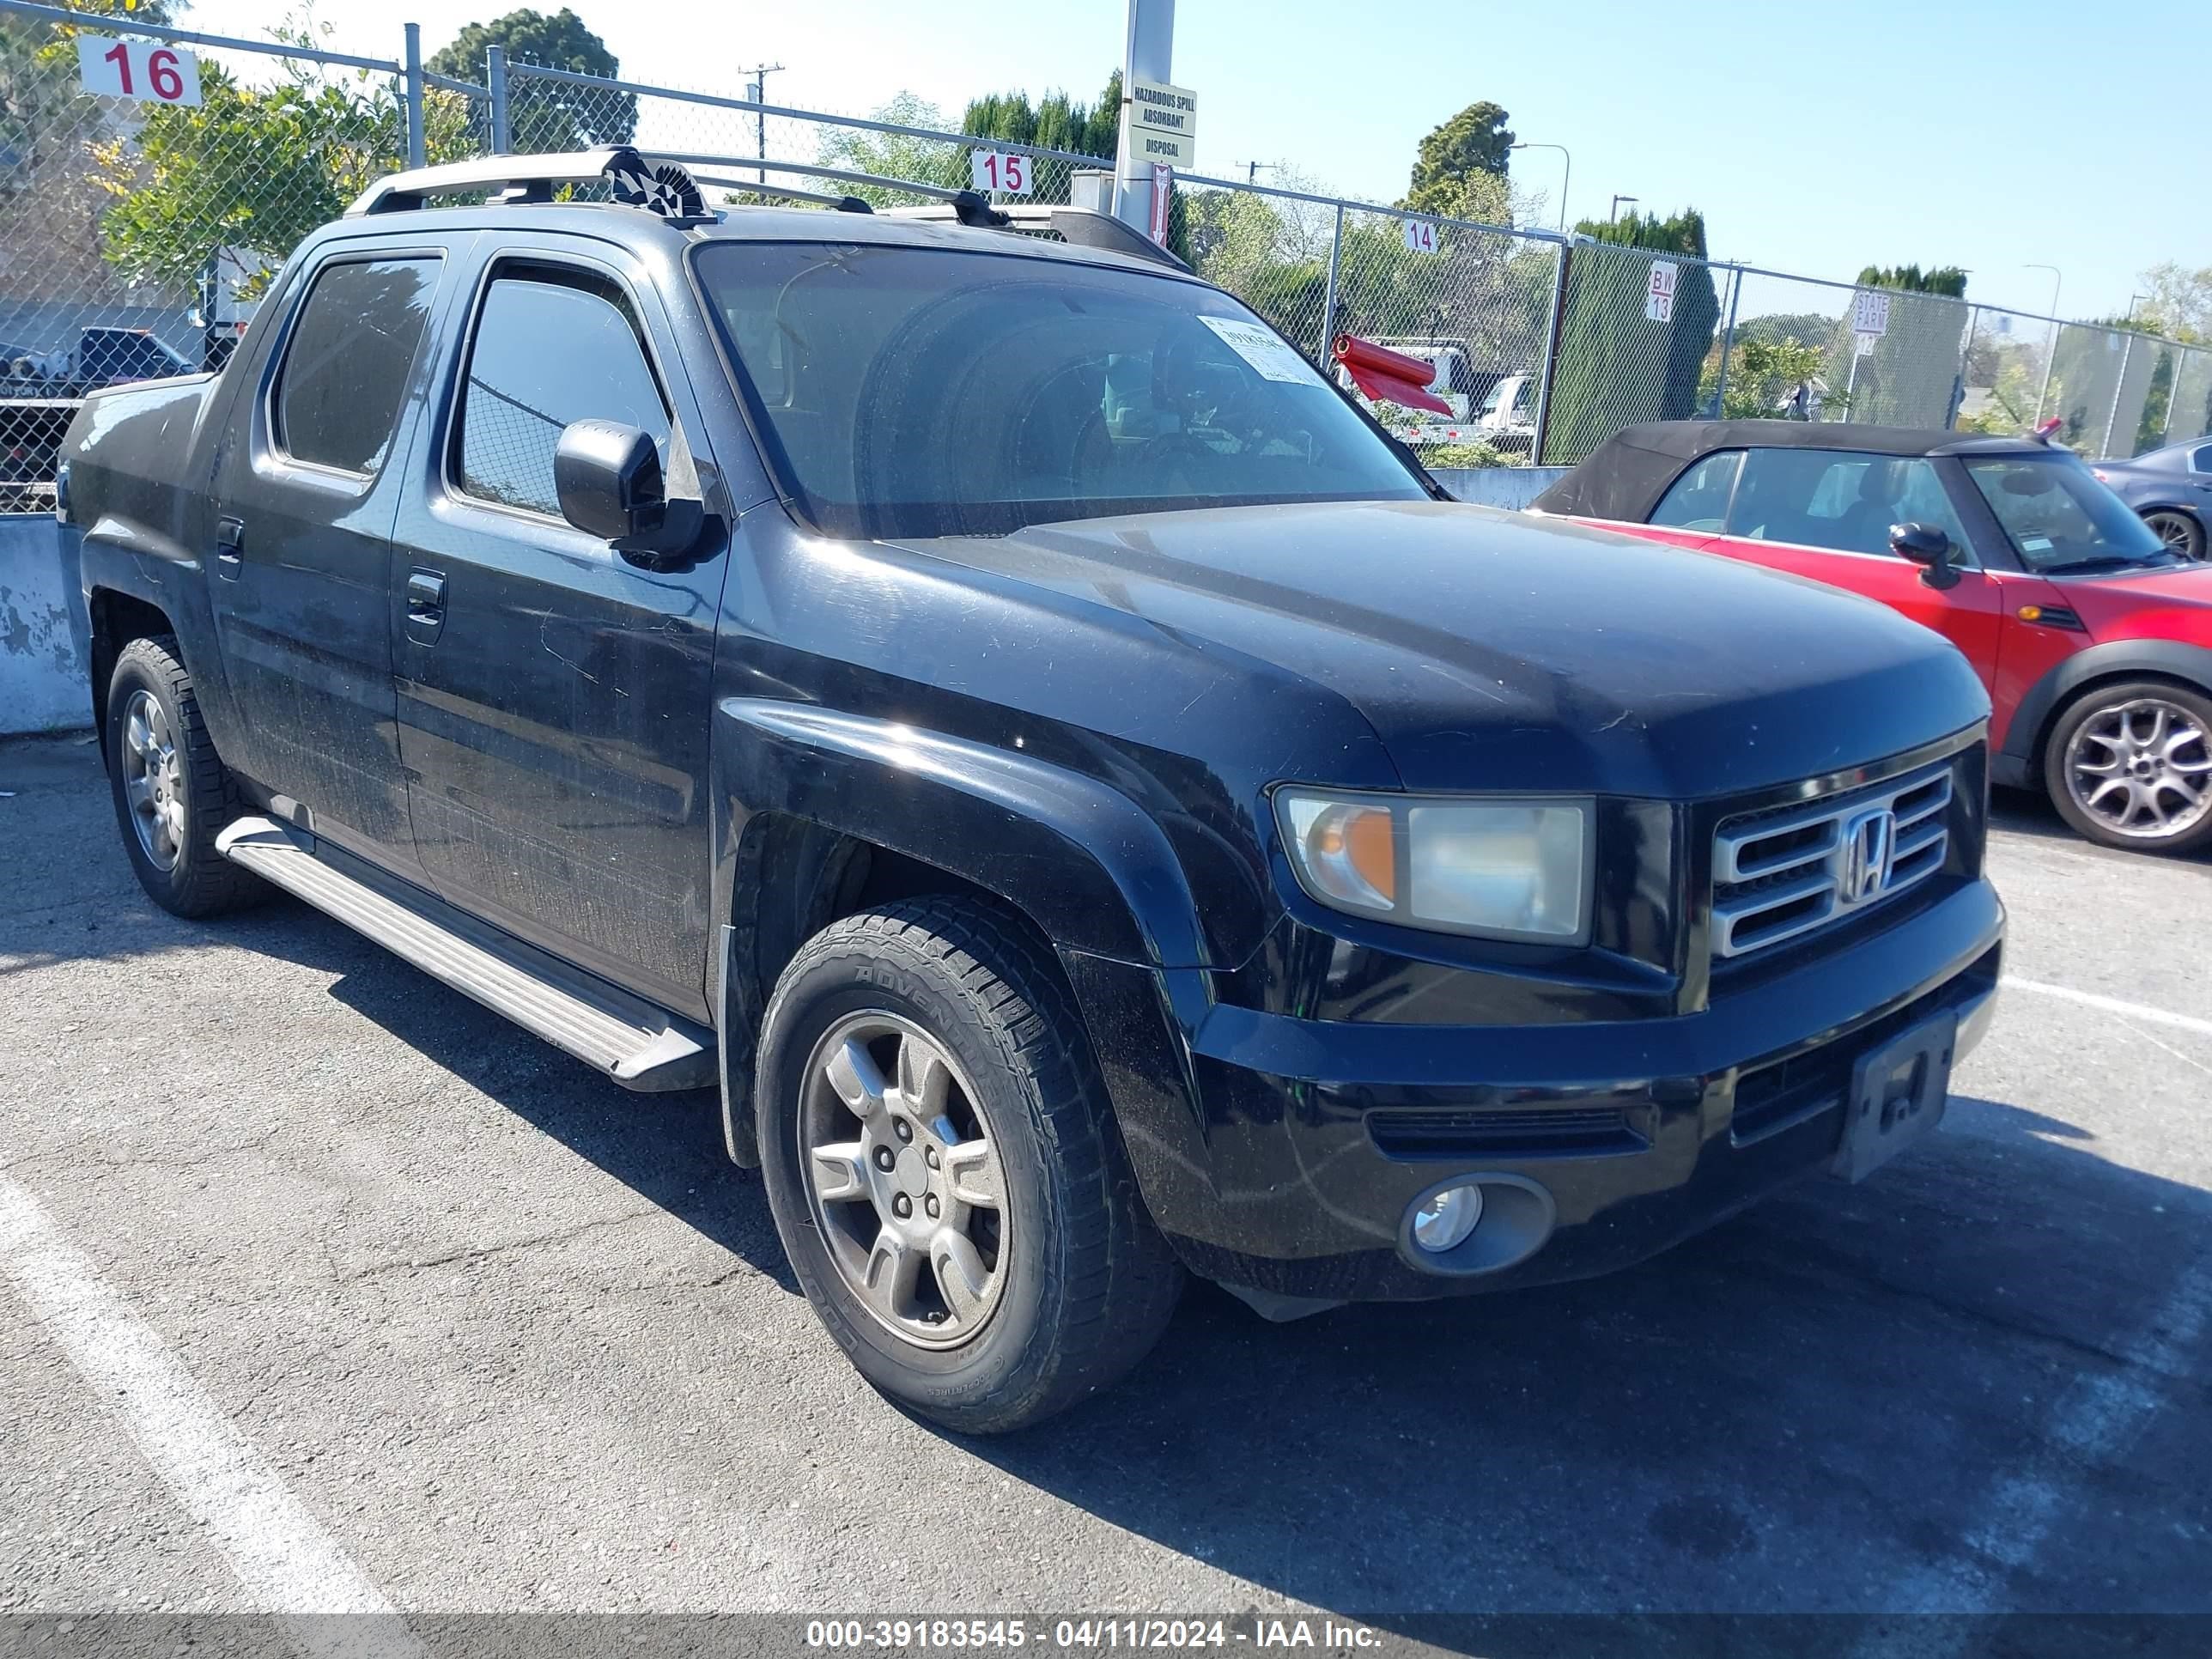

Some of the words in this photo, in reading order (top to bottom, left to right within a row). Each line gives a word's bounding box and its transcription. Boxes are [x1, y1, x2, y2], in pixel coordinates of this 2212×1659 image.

[104, 43, 184, 100] 16
[1134, 86, 1176, 108] HAZARDOUS
[1176, 95, 1194, 112] SPILL
[1143, 108, 1185, 129] ABSORBANT
[1146, 138, 1179, 157] DISPOSAL
[984, 155, 1022, 191] 15
[1156, 174, 1168, 185] FIRE
[1411, 222, 1431, 251] 14
[1653, 270, 1674, 292] BW
[1653, 296, 1669, 319] 13
[1858, 294, 1888, 313] STATE
[1856, 310, 1887, 329] FARM
